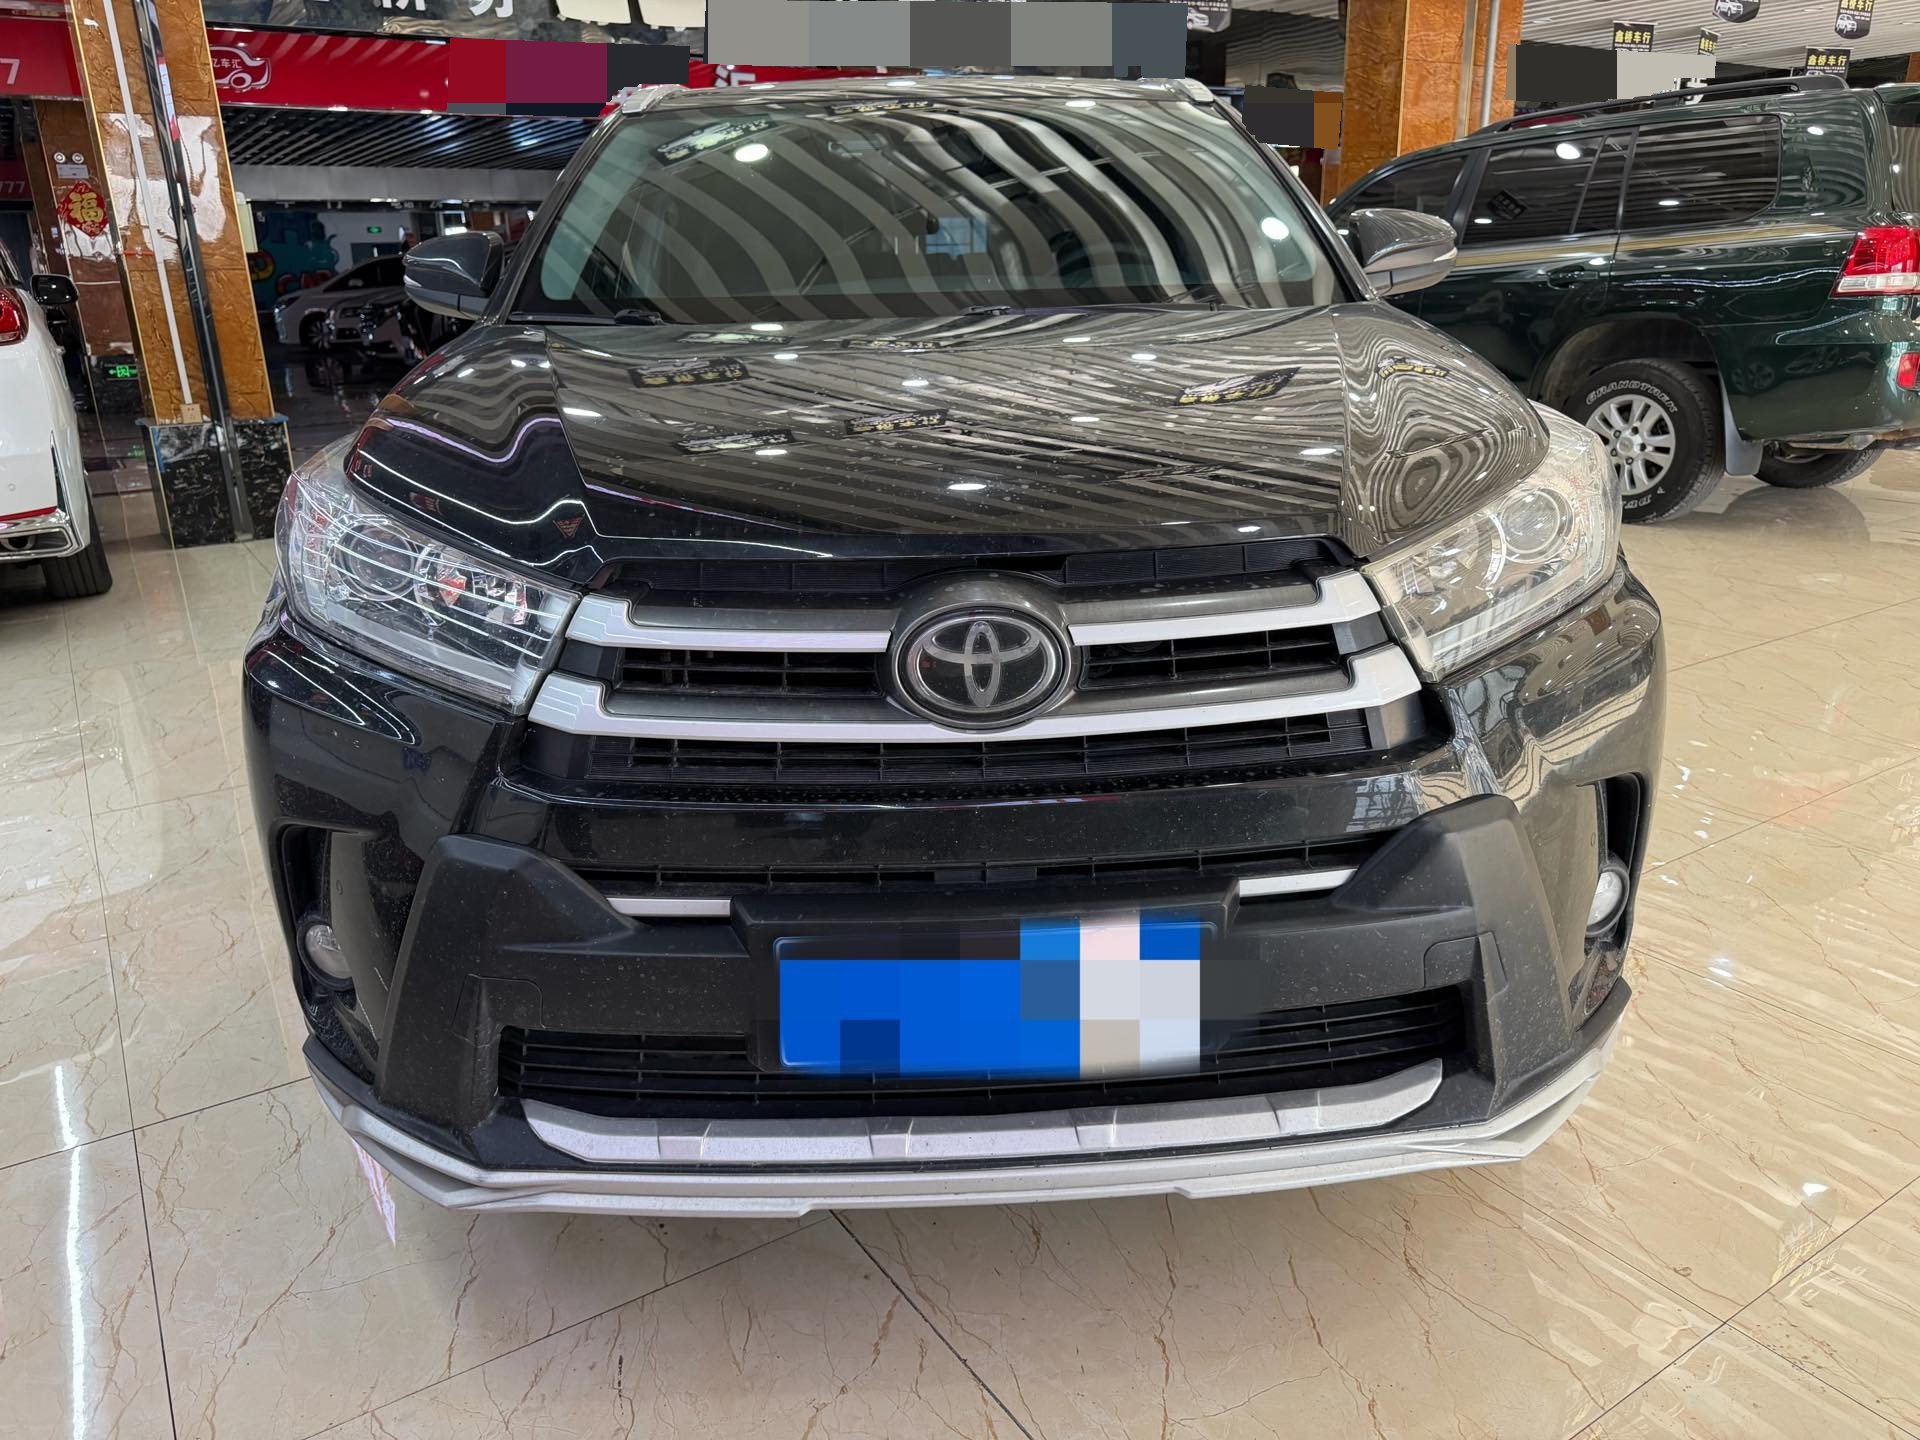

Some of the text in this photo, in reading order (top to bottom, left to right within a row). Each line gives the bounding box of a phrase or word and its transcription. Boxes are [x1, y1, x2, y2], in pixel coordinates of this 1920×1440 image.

[1808, 54, 1847, 66] 鑫桥车行
[68, 192, 104, 223] 福
[1586, 380, 1678, 412] GRANDTREK
